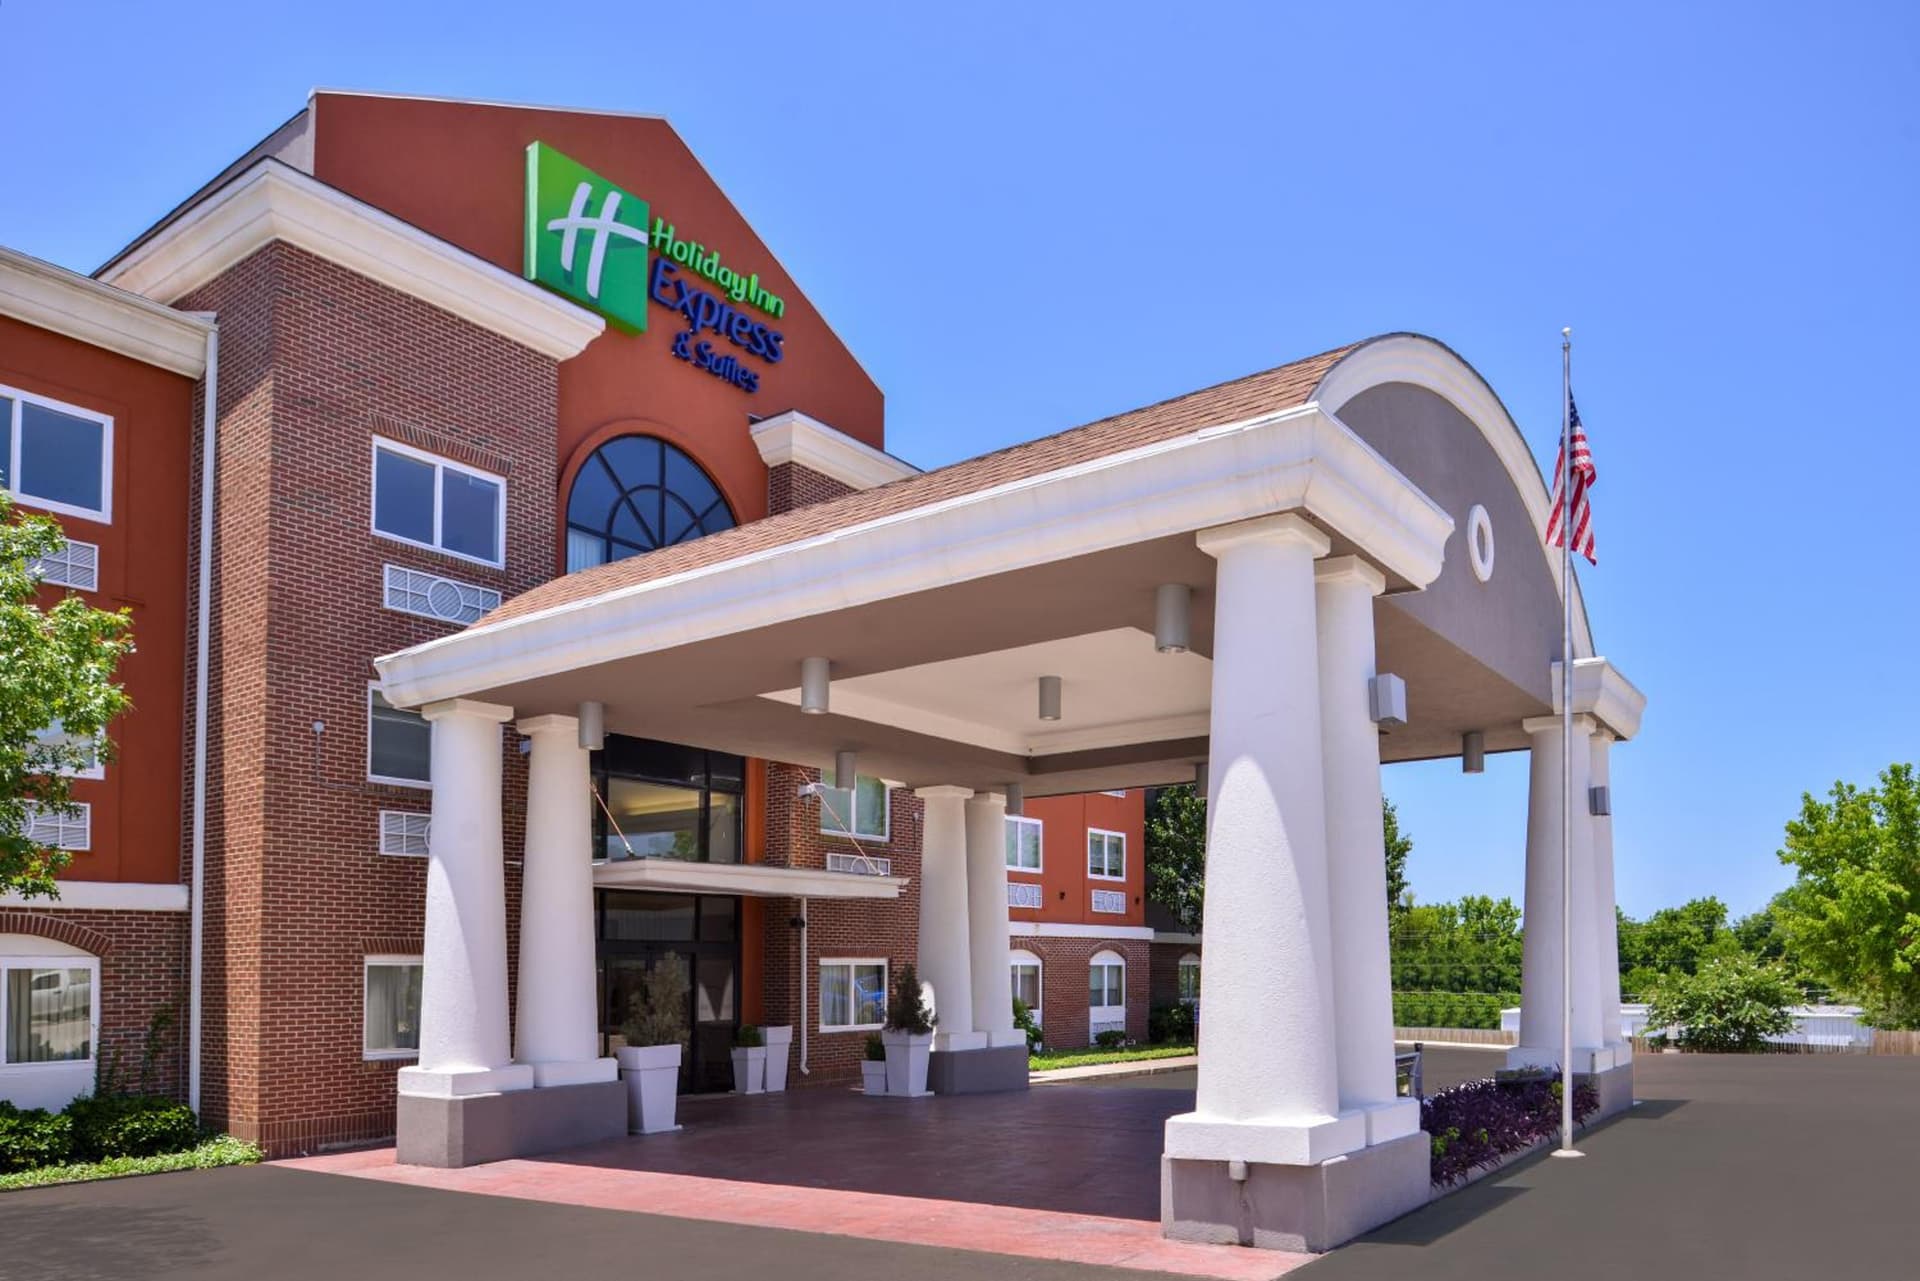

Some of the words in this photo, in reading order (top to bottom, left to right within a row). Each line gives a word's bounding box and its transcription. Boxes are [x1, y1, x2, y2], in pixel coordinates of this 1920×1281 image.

[651, 257, 785, 364] Express
[673, 331, 692, 360] &
[696, 341, 760, 394] Suites
